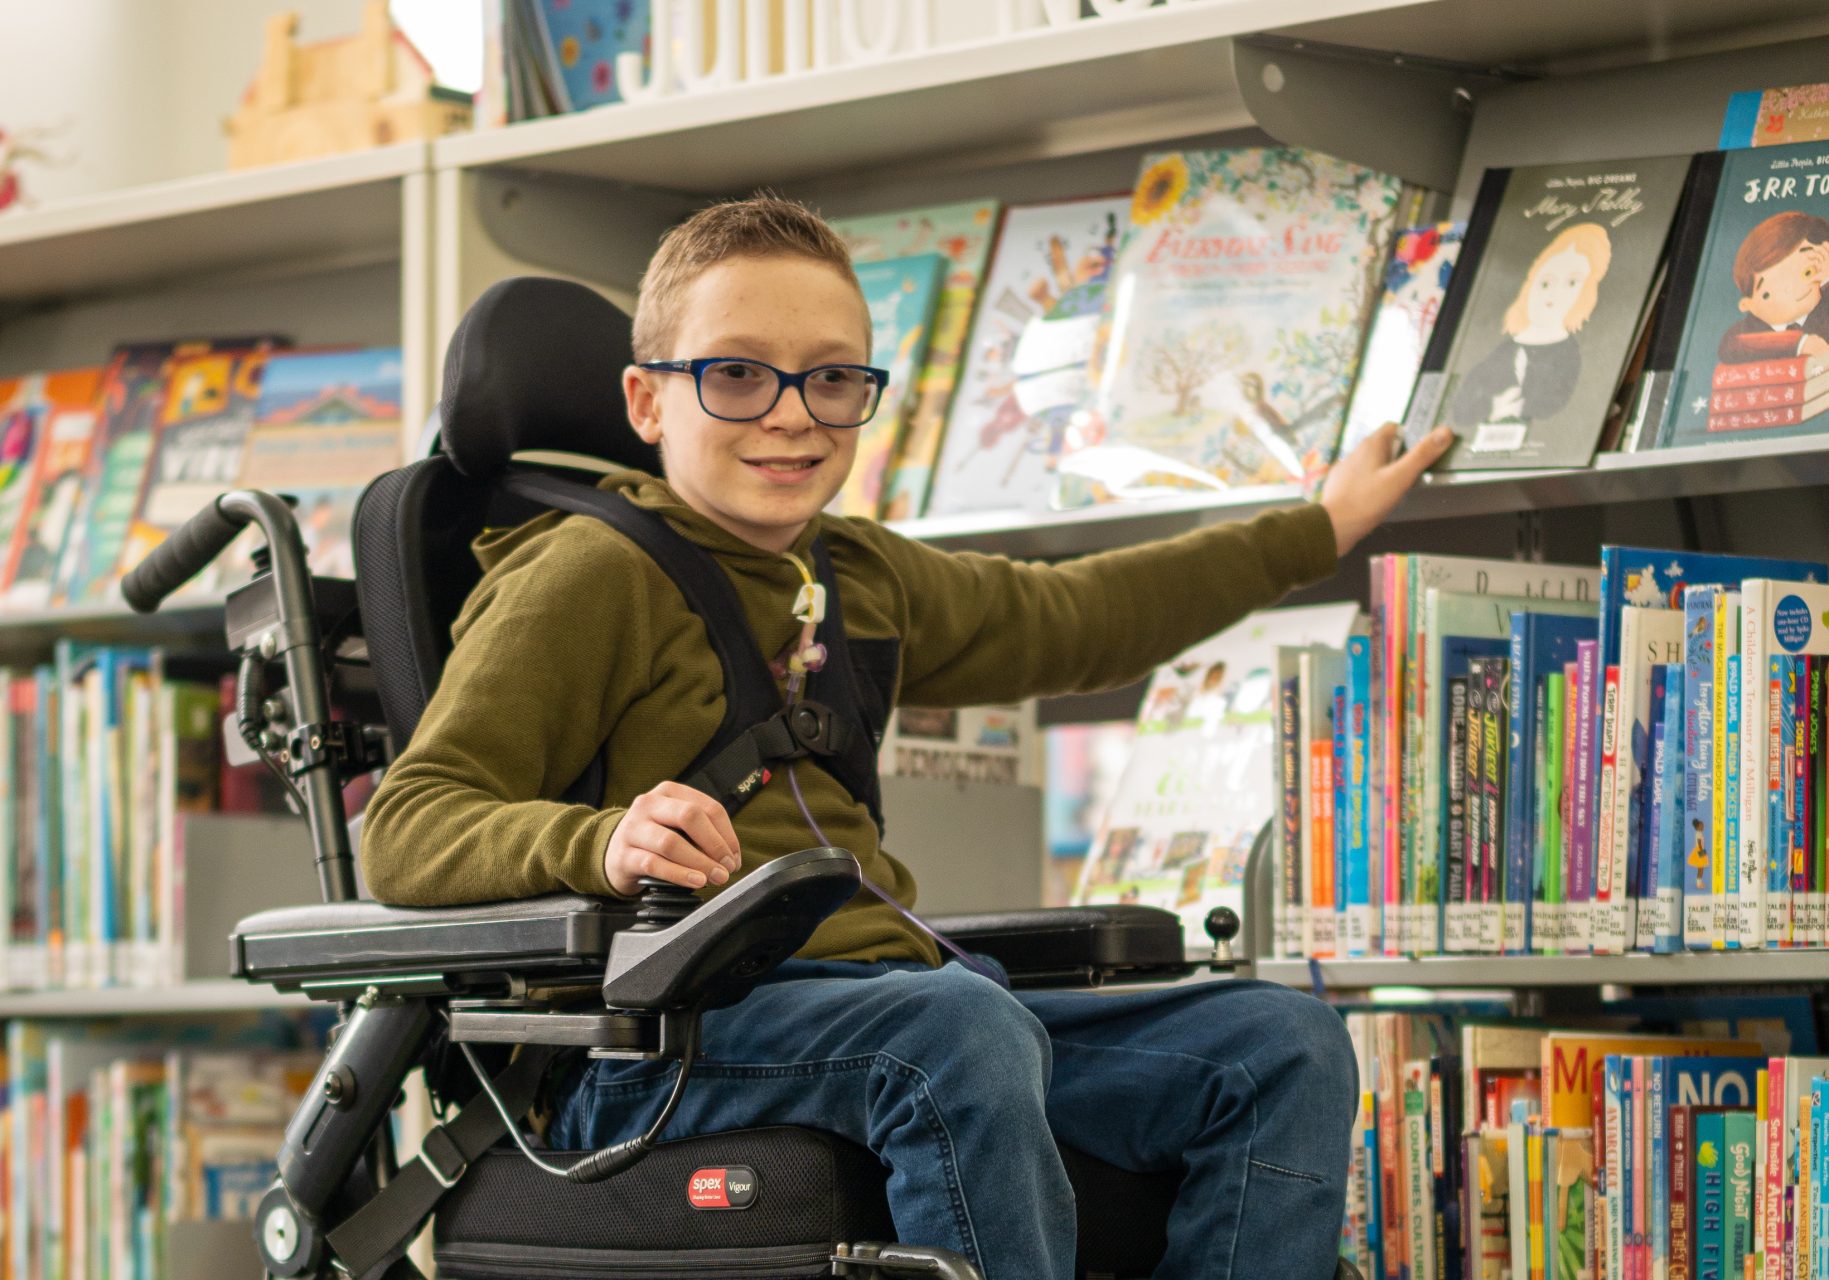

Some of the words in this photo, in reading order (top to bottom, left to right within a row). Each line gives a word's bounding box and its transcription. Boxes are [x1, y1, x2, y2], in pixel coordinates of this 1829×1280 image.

[1523, 196, 1580, 231] Mary
[1582, 188, 1644, 227] Shelley
[1715, 622, 1723, 640] THE
[1582, 650, 1593, 683] WHEN
[1745, 621, 1756, 685] Children's
[1452, 684, 1466, 725] GONE
[1581, 683, 1592, 720] POEMS
[1693, 682, 1712, 735] Forgotten
[1728, 696, 1738, 724] DAHL
[1742, 689, 1756, 745] Treasury
[1769, 688, 1779, 731] FOOTBALL
[1467, 709, 1482, 780] JOKIEST
[1483, 712, 1500, 784] JOKIEST
[1580, 722, 1590, 749] FALL
[1769, 732, 1779, 760] JOKES
[1795, 720, 1804, 757] JOKES
[1809, 714, 1818, 754] JOKES
[1450, 743, 1465, 801] WOODS
[1579, 751, 1589, 782] FROM
[1655, 740, 1665, 774] ROALD
[1715, 736, 1723, 792] HANDBOOK
[1745, 750, 1756, 764] of
[737, 768, 761, 793] spex
[1578, 784, 1587, 807] THE
[1652, 777, 1664, 806] DAHL
[1697, 774, 1713, 802] Tales
[1727, 779, 1739, 819] JOKES
[1742, 767, 1756, 822] Milligan
[1470, 795, 1480, 866] BATHROOM
[1577, 808, 1586, 827] SKY
[1614, 745, 1627, 895] SHAKESPEARE
[1450, 819, 1464, 859] GARY
[1449, 863, 1463, 901] PAUL
[1653, 1072, 1661, 1092] NO
[1653, 1094, 1661, 1139] RETURN
[1770, 1118, 1780, 1138] See
[1606, 1106, 1618, 1191] ANTARCTICA
[1769, 1142, 1780, 1177] Inside
[1801, 1137, 1807, 1156] WE
[693, 1178, 721, 1193] spex
[729, 1182, 751, 1193] Vigour
[1704, 1171, 1721, 1232] HIGH
[1670, 1203, 1685, 1229] HOW
[1766, 1182, 1781, 1249] Ancient
[1799, 1204, 1808, 1249] ANCIENT
[1672, 1233, 1686, 1261] THEY
